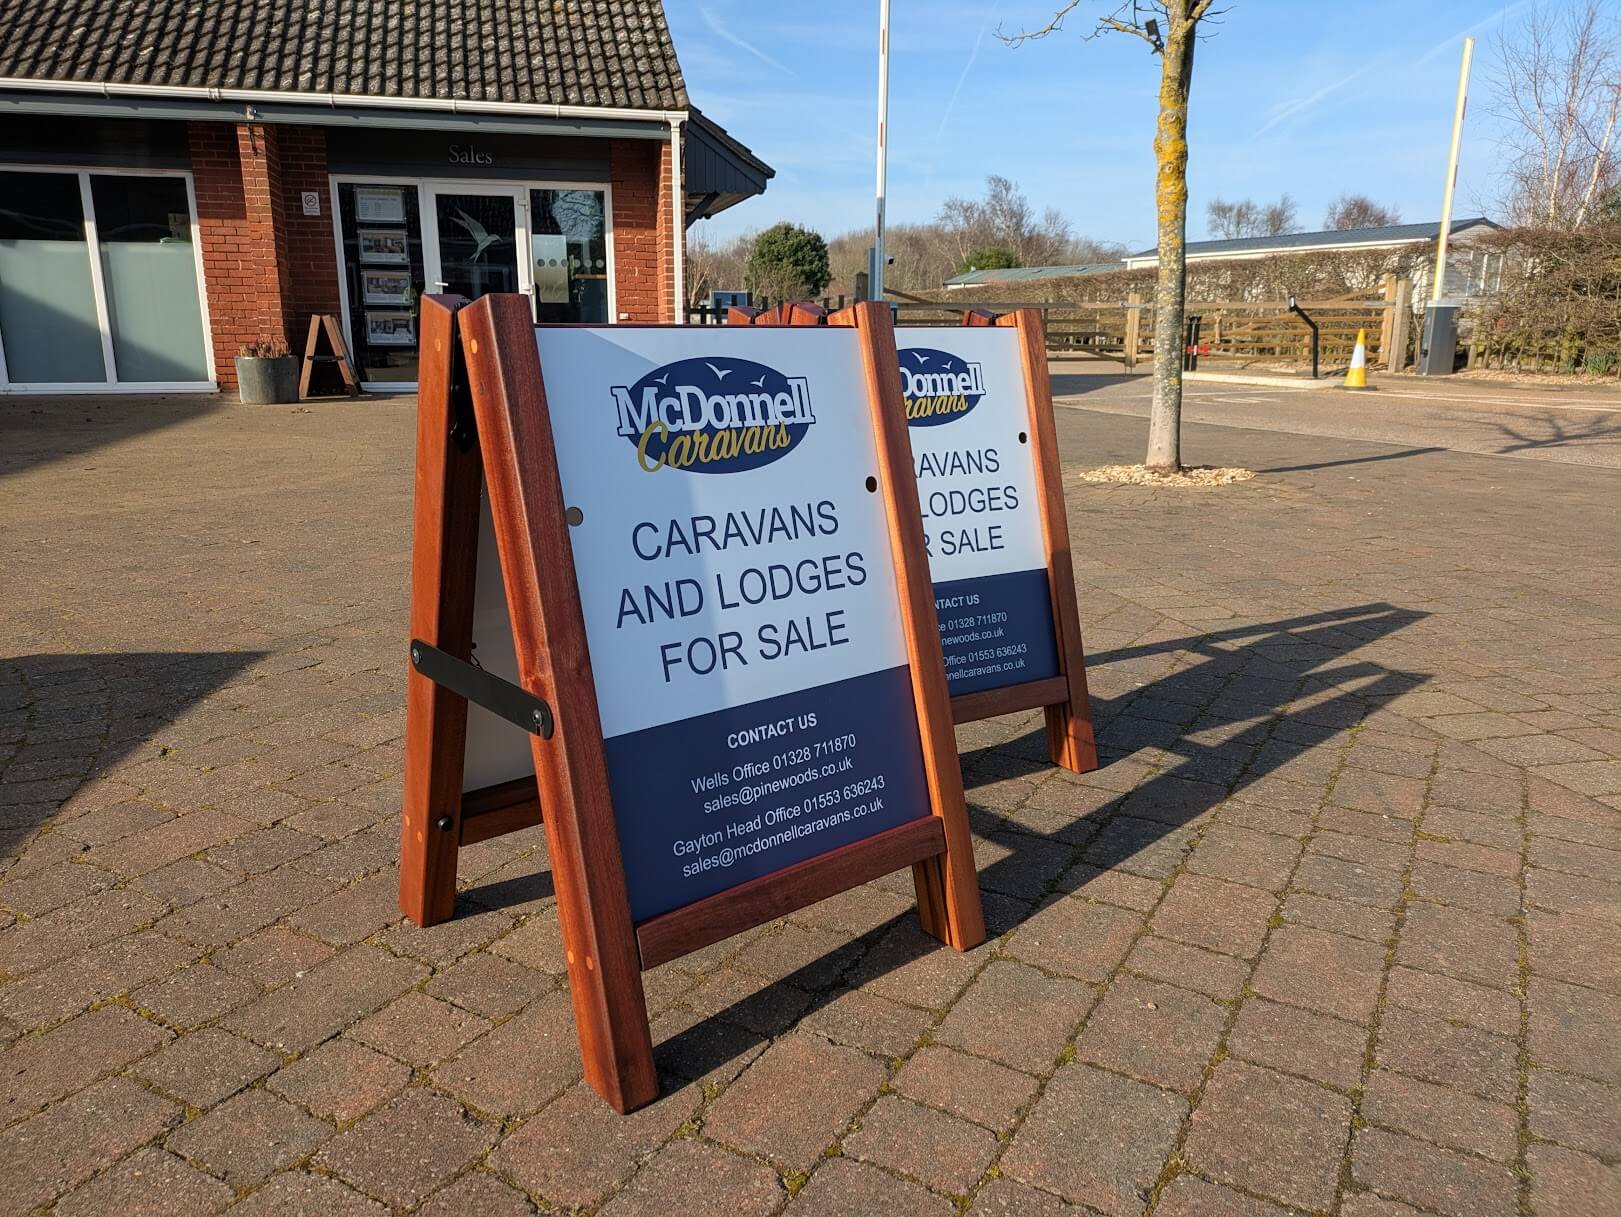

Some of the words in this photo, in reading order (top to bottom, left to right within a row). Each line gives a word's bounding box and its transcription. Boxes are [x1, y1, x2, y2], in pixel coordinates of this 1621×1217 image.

[449, 143, 493, 164] Sales
[900, 361, 986, 397] Donnell
[611, 376, 816, 436] McDonnell
[637, 420, 791, 473] Caravans
[915, 448, 1000, 479] AVANS
[632, 500, 839, 561] CARAVANS
[940, 525, 1005, 556] SALE
[616, 578, 704, 629] AND
[717, 552, 867, 610] LODGES
[966, 594, 980, 606] US
[660, 631, 748, 683] FOR
[757, 610, 850, 660] SALE
[947, 616, 975, 631] 01328
[976, 611, 1007, 626] 711870
[968, 648, 995, 662] 01553
[996, 643, 1028, 658] 636243
[727, 718, 795, 749] CONTACT
[798, 712, 818, 730] US
[691, 772, 730, 794] Wells
[732, 762, 770, 782] Office
[772, 747, 812, 770] 01328
[813, 733, 857, 758] 711870
[703, 757, 854, 814] sales@pinewoods.co.uk
[673, 831, 724, 857] Gayton
[726, 814, 762, 840] Head
[764, 804, 801, 827] Office
[803, 789, 841, 813] 01553
[843, 775, 886, 800] 636243
[682, 797, 884, 878] sales@mcdonnellcaravans.co.uk
